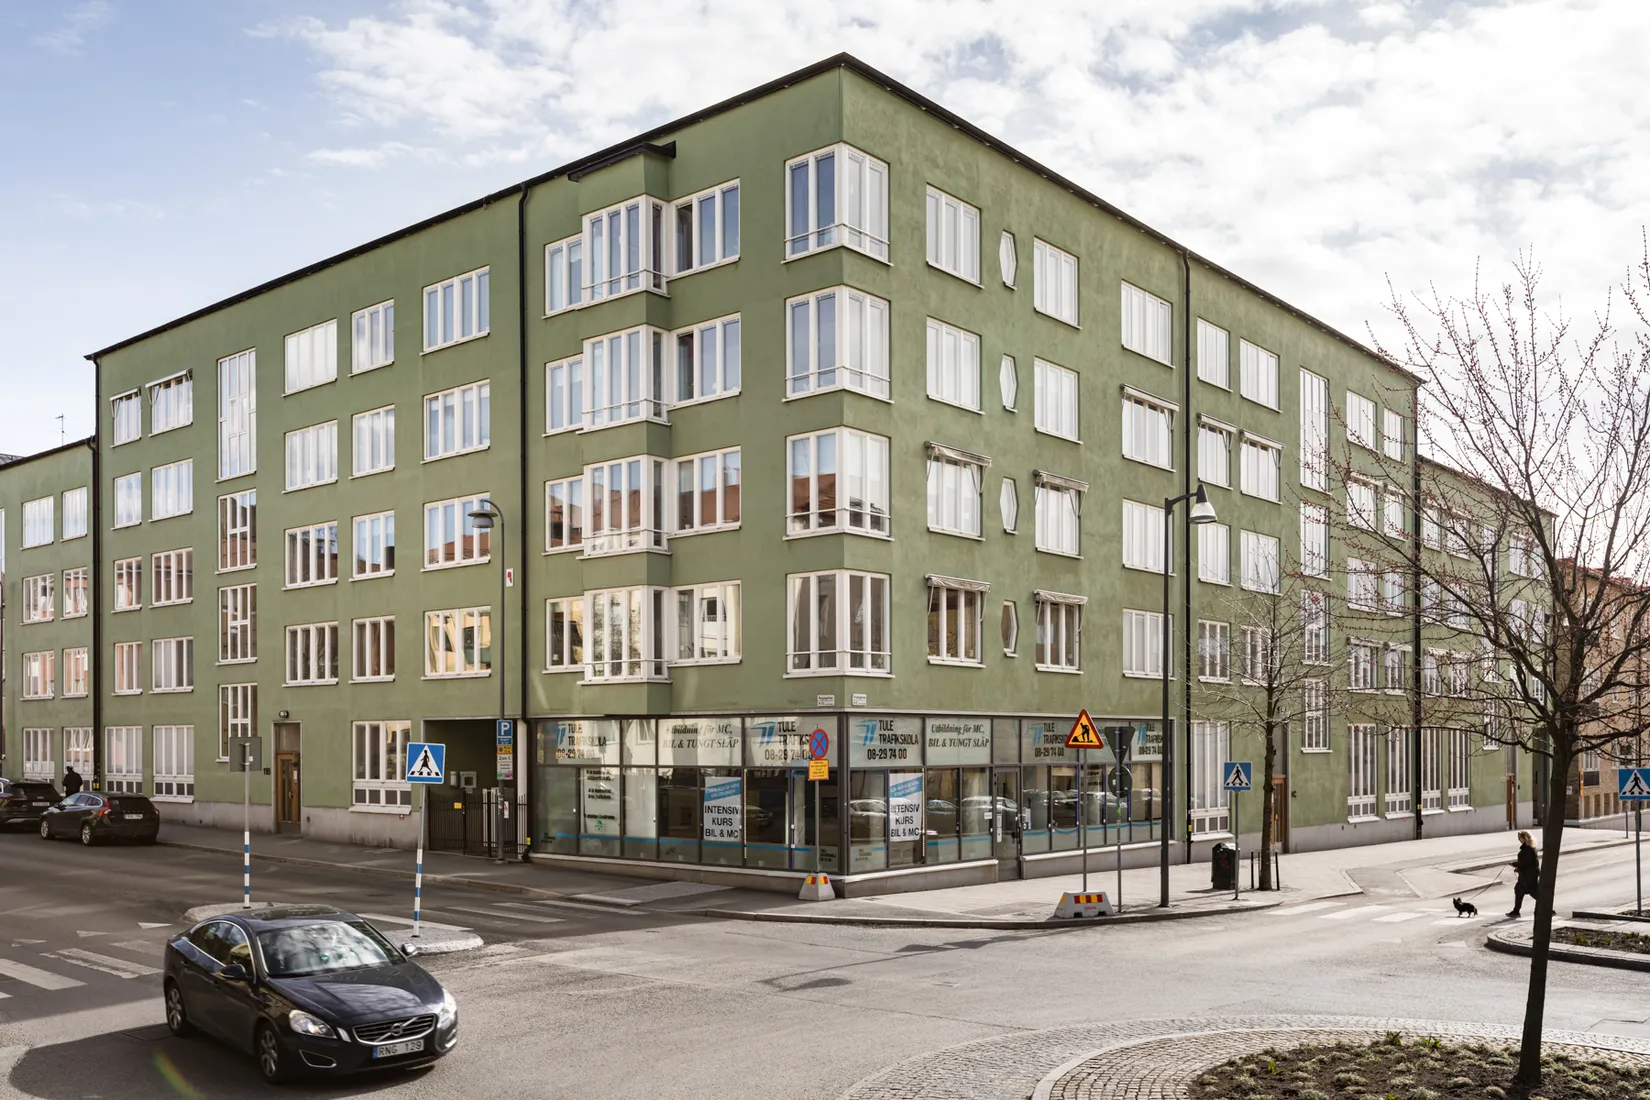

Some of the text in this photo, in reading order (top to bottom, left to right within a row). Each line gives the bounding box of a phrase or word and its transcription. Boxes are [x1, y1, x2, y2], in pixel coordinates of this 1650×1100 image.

[501, 722, 510, 736] P
[568, 723, 582, 734] TULE
[716, 723, 733, 735] MC,
[777, 721, 796, 733] TULE
[879, 719, 894, 731] TULE
[931, 723, 962, 735] Utbildning
[962, 723, 972, 735] för
[1043, 722, 1055, 733] TULE
[662, 736, 739, 749] BIL & TUNGT SLÄP
[879, 733, 919, 745] TRAFIKSKOLA
[928, 736, 990, 748] BIL & TUNGT SLÄP
[764, 748, 788, 761] 08-29
[790, 749, 801, 761] 74
[867, 748, 907, 760] 08-29 74 00
[1034, 746, 1064, 757] 08-29 74 00
[704, 804, 739, 815] INTENSIV
[889, 803, 920, 813] INTENSIV
[711, 817, 733, 827] KURS
[895, 815, 914, 825] KURS
[705, 828, 739, 839] BIL & MC
[890, 827, 920, 838] BIL & MC
[379, 1040, 422, 1056] RNG 129
